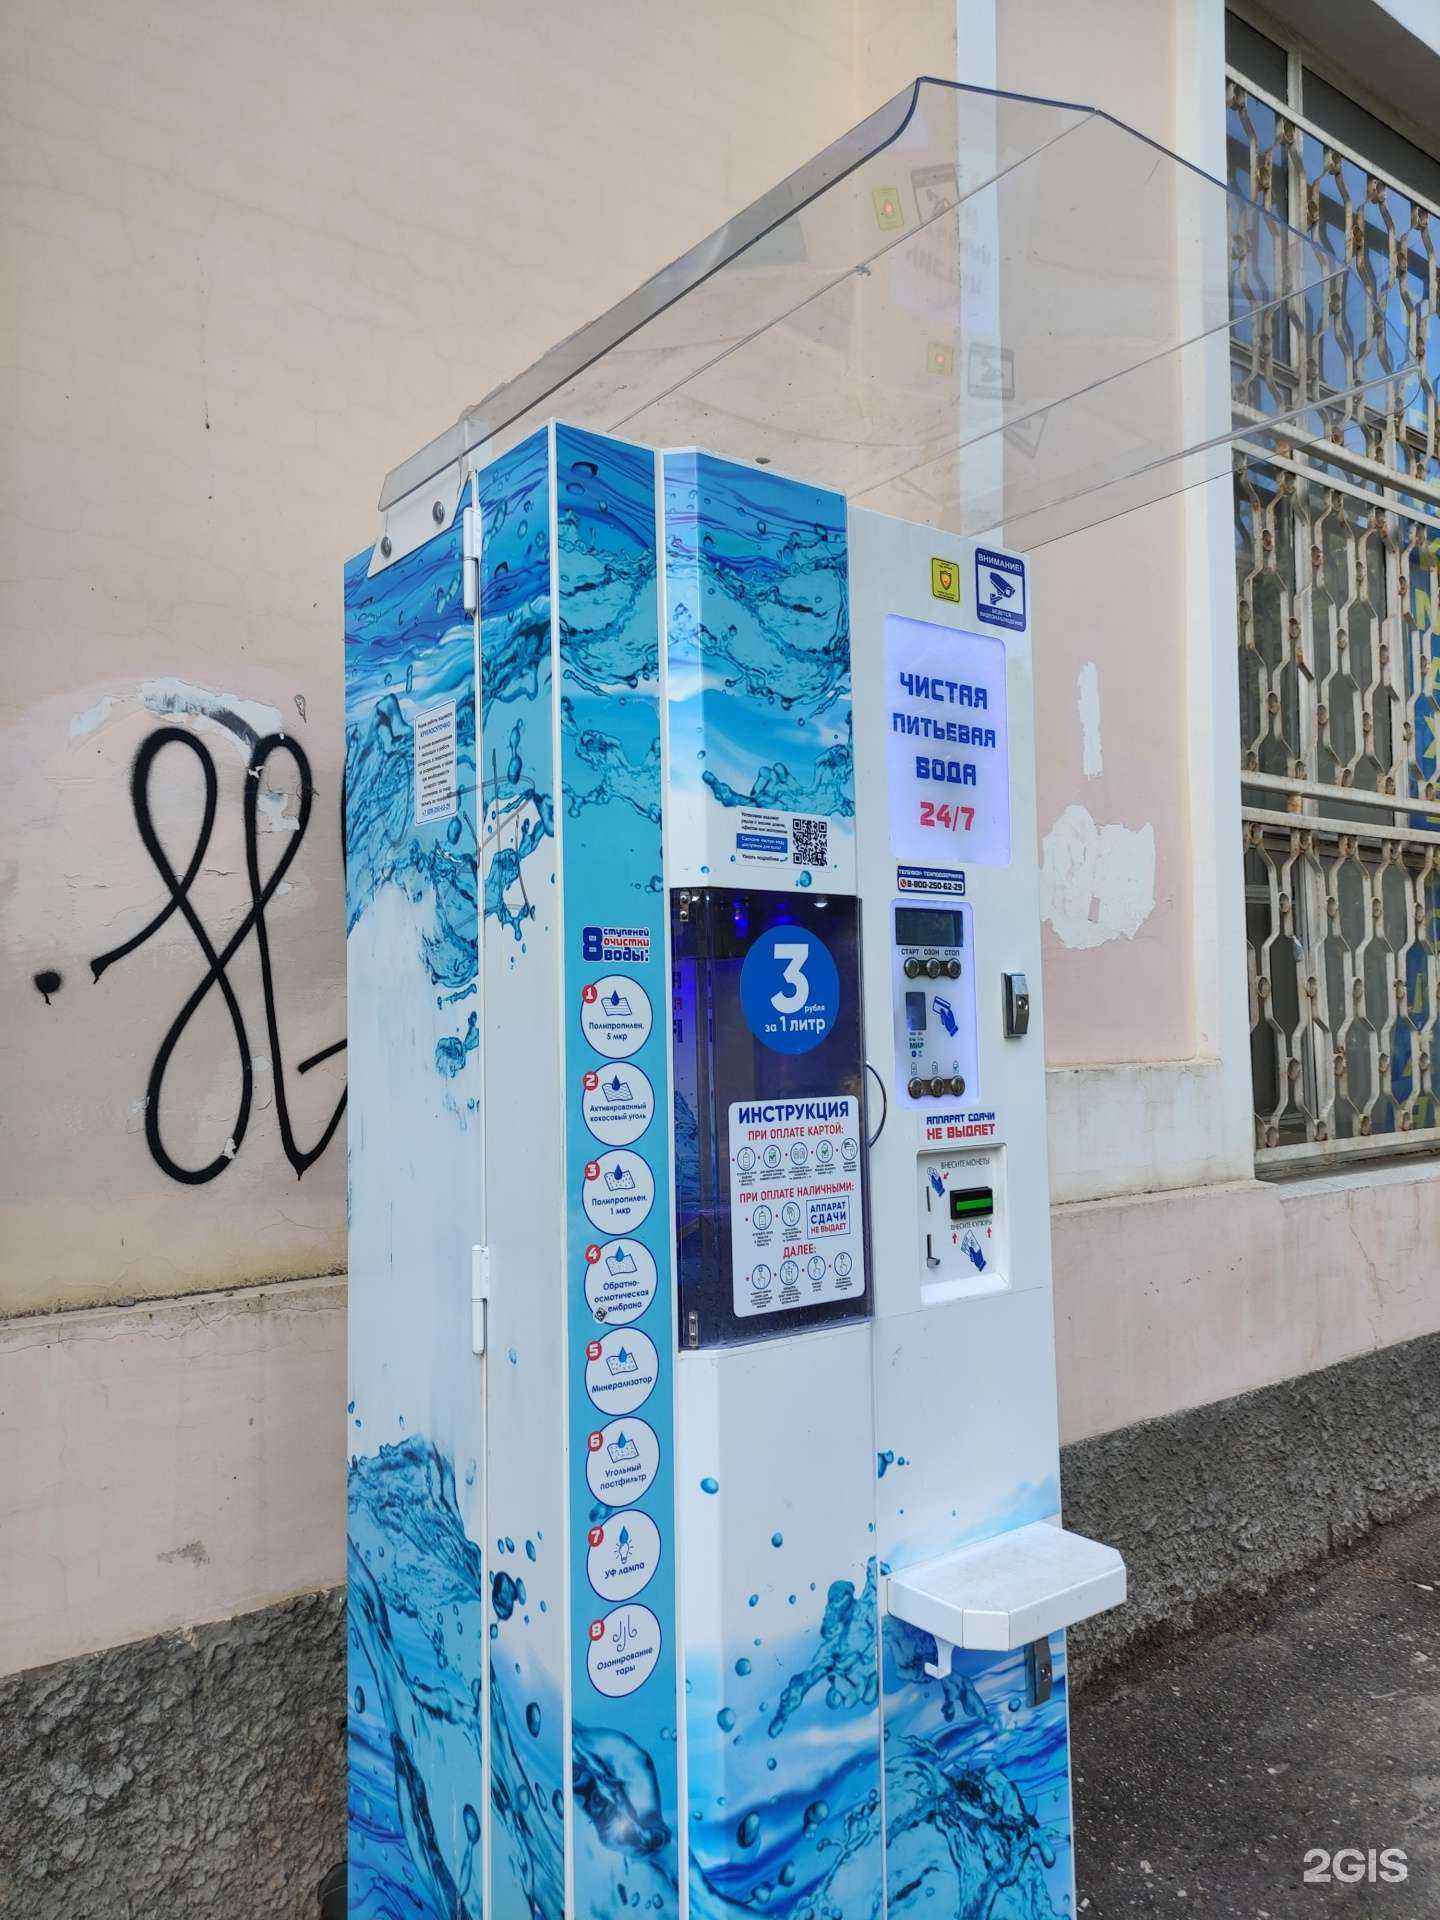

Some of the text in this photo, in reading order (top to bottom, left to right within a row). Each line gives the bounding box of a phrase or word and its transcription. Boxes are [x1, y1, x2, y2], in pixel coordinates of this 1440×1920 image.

[978, 553, 1023, 572] ВНИМАНИЕ!
[899, 671, 988, 710] ЧИСТАЯ
[892, 712, 996, 749] ПИТЬЕВАЯ
[915, 755, 977, 786] ВОДА
[919, 801, 975, 832] 24/7
[583, 926, 650, 962] 8 ступеней
[603, 938, 650, 947] очистки
[603, 948, 650, 962] воды:
[901, 948, 920, 956] СТАРТ
[770, 943, 810, 1014] 3
[585, 987, 594, 1000] 1
[588, 1020, 645, 1032] Полипропилен,
[764, 1016, 826, 1034] за 1 литр
[606, 1032, 628, 1042] 5 мкр
[586, 1074, 596, 1087] 2
[589, 1101, 647, 1113] Активированный
[738, 1100, 849, 1125] ИНСТРУКЦИЯ
[590, 1112, 647, 1123] кокосовый уголь
[926, 1111, 996, 1125] АППАРАТ СДАЧИ
[748, 1121, 845, 1141] ПРИ ОПЛАТЕ КАРТОЙ:
[926, 1123, 996, 1140] НЕ ВЫДАЕТ
[587, 1164, 597, 1177] 3
[739, 1181, 855, 1204] ПРИ ОПЛАТЕ НАЛИЧНЫМИ:
[615, 1206, 631, 1216] мкр
[810, 1201, 847, 1214] АППАРАТ
[810, 1211, 847, 1226] СДАЧИ
[810, 1225, 820, 1235] НЕ
[820, 1222, 847, 1234] ВЫДАЕТ
[588, 1247, 598, 1261] 4
[782, 1243, 817, 1260] ДАЛЕЕ:
[603, 1279, 641, 1291] Обратно-
[594, 1289, 650, 1303] осмотическая
[606, 1301, 643, 1313] ембрана
[589, 1344, 599, 1357] 5
[591, 1376, 653, 1394] Минерализатор
[590, 1434, 600, 1448] 6
[604, 1462, 642, 1477] Угольный
[600, 1473, 647, 1491] постфильтр
[590, 1529, 601, 1544] 7
[604, 1562, 645, 1579] УФ лампа
[591, 1622, 602, 1637] 8
[597, 1646, 653, 1670] Озонирование
[615, 1665, 636, 1676] тары
